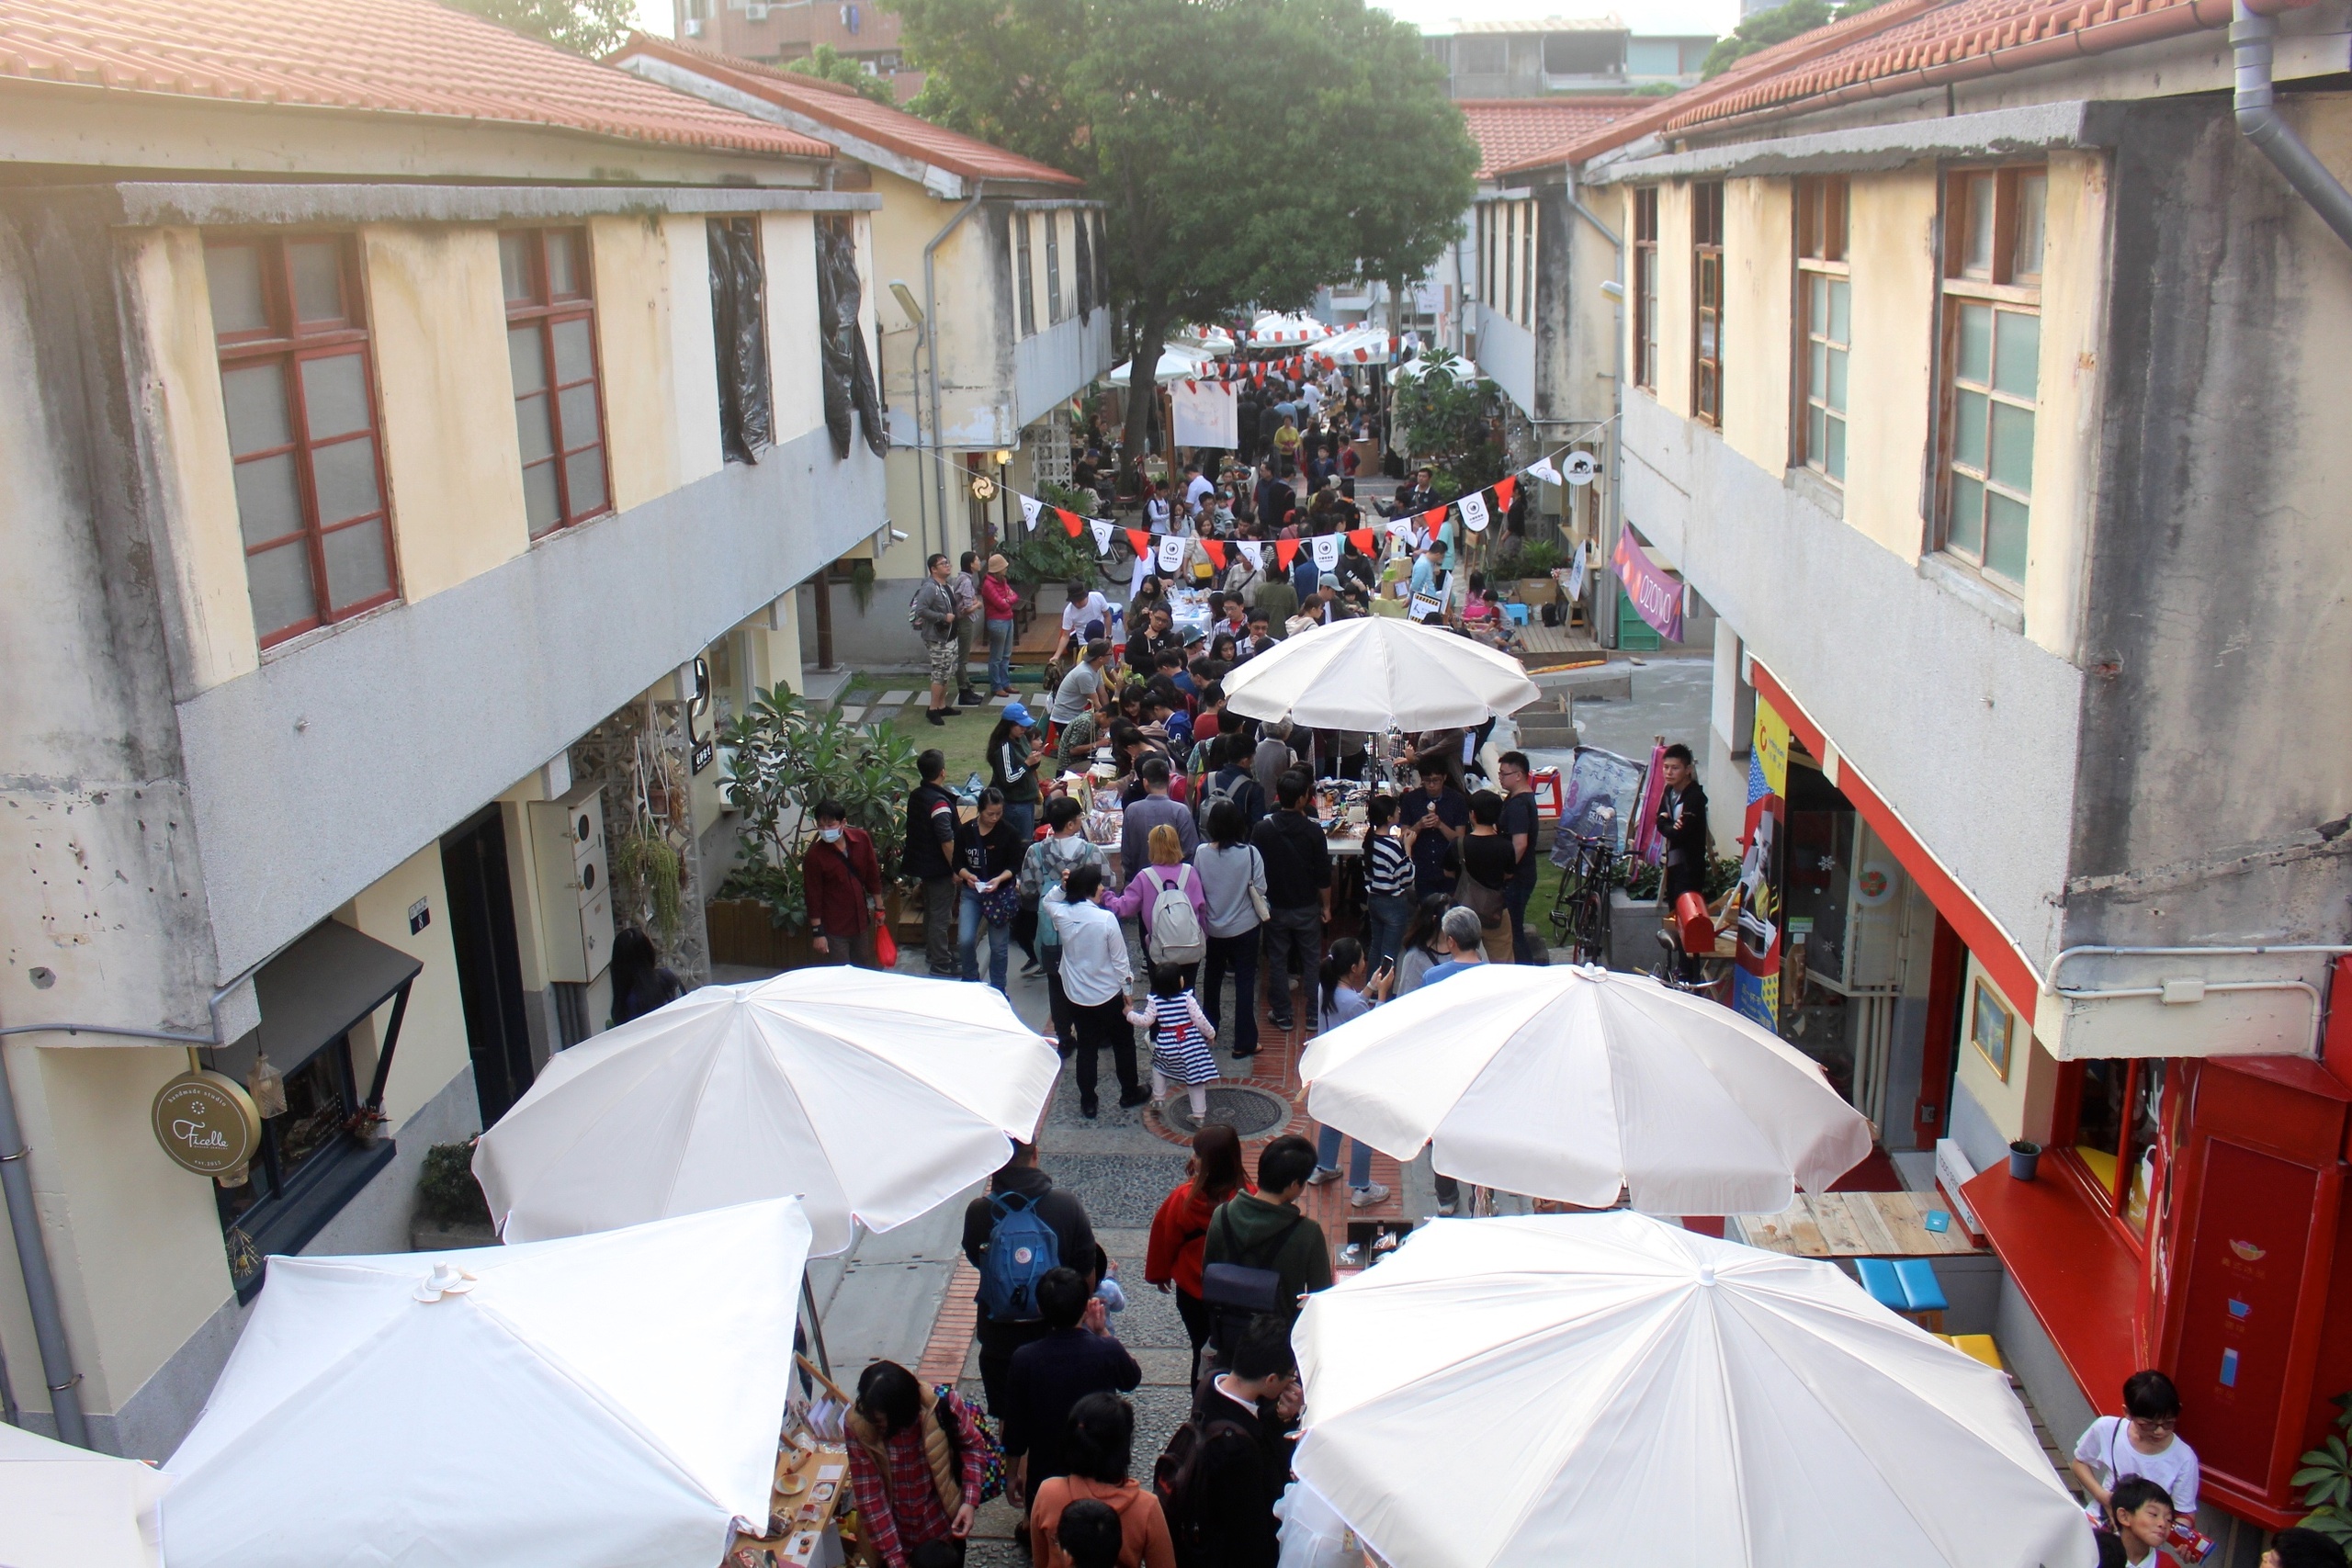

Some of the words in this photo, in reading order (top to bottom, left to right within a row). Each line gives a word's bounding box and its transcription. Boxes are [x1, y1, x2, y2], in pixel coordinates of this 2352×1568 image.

[418, 914, 424, 929] 8
[168, 1089, 200, 1103] handmade
[204, 1091, 226, 1107] studio
[173, 1120, 229, 1148] Ficelle
